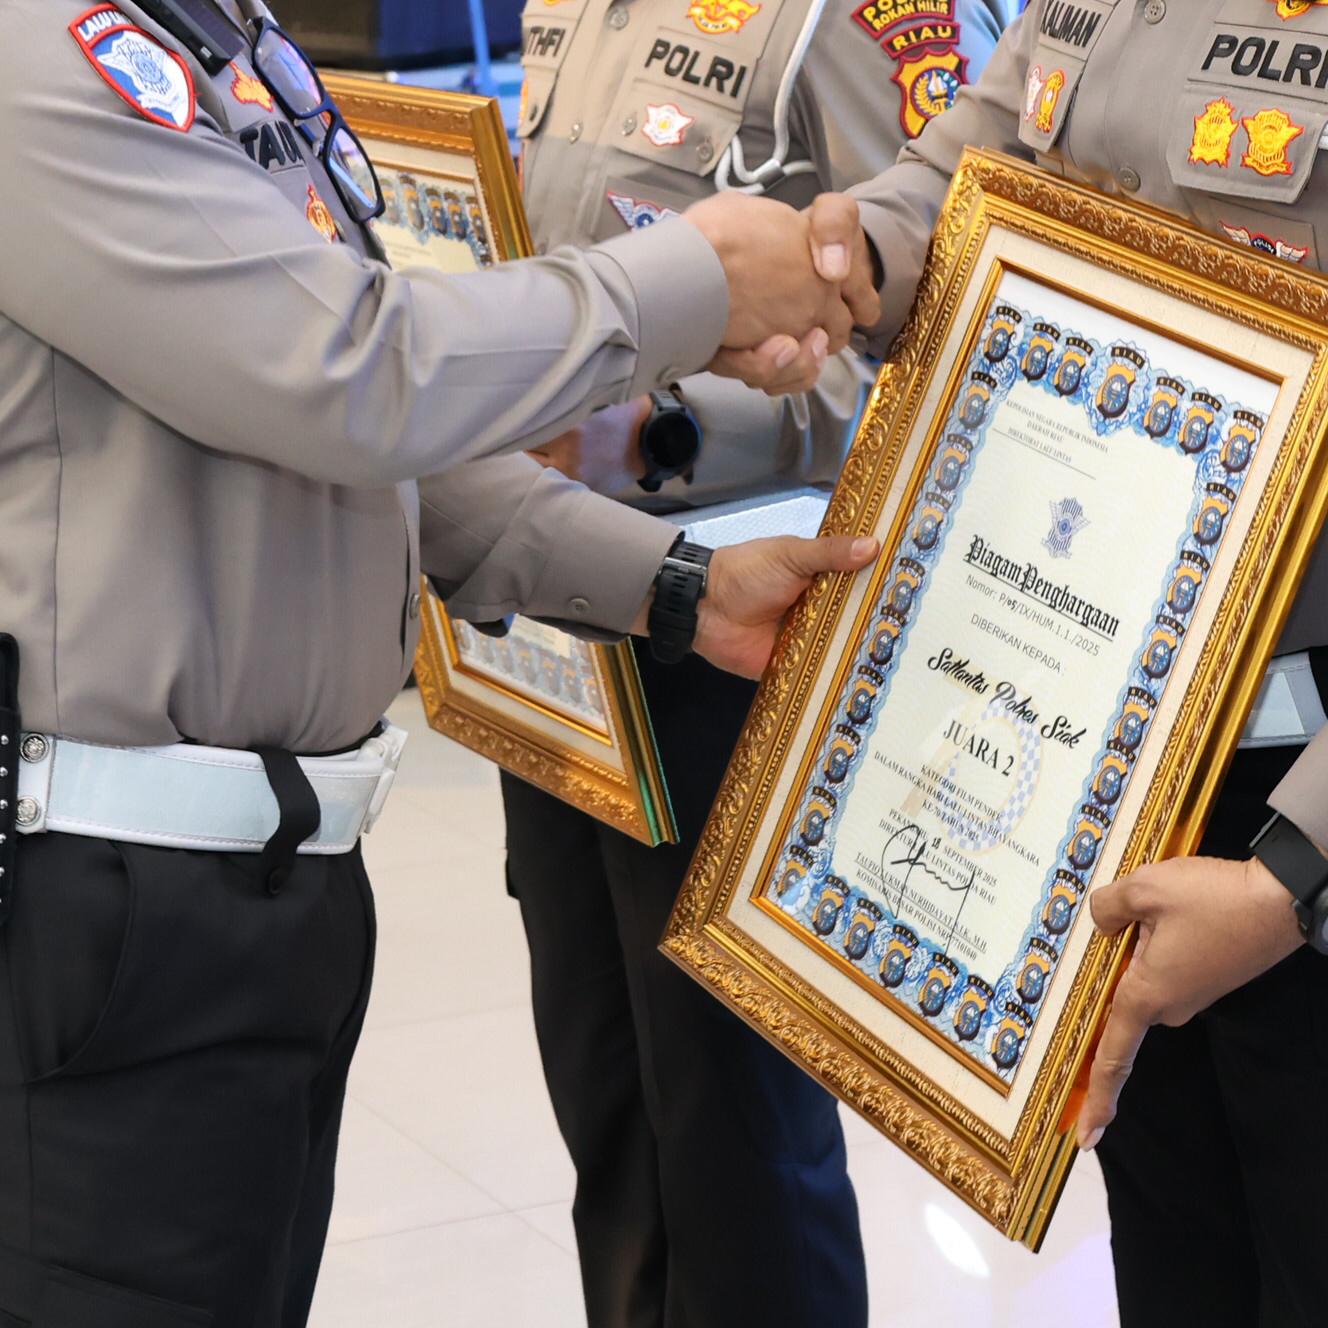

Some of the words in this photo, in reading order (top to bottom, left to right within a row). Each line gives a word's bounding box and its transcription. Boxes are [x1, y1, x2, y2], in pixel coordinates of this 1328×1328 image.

[872, 2, 916, 31] ROKAN
[916, 0, 949, 15] HILIR
[892, 25, 952, 51] RIAU
[644, 38, 748, 98] POLRI
[1113, 343, 1144, 366] RIAU
[965, 574, 997, 599] Nomor:
[971, 612, 1023, 650] DIBERIKAN
[1022, 642, 1061, 672] KEPADA
[927, 647, 990, 695] Satlantas
[989, 680, 1039, 725] Polres
[1040, 715, 1088, 750] Siak
[943, 719, 1000, 771] JUARA
[1001, 754, 1015, 777] 2
[874, 751, 898, 772] DALAM
[898, 767, 927, 791] RANGKA
[926, 785, 944, 802] HARI
[920, 765, 956, 793] KATEGORI
[956, 788, 974, 804] FILM
